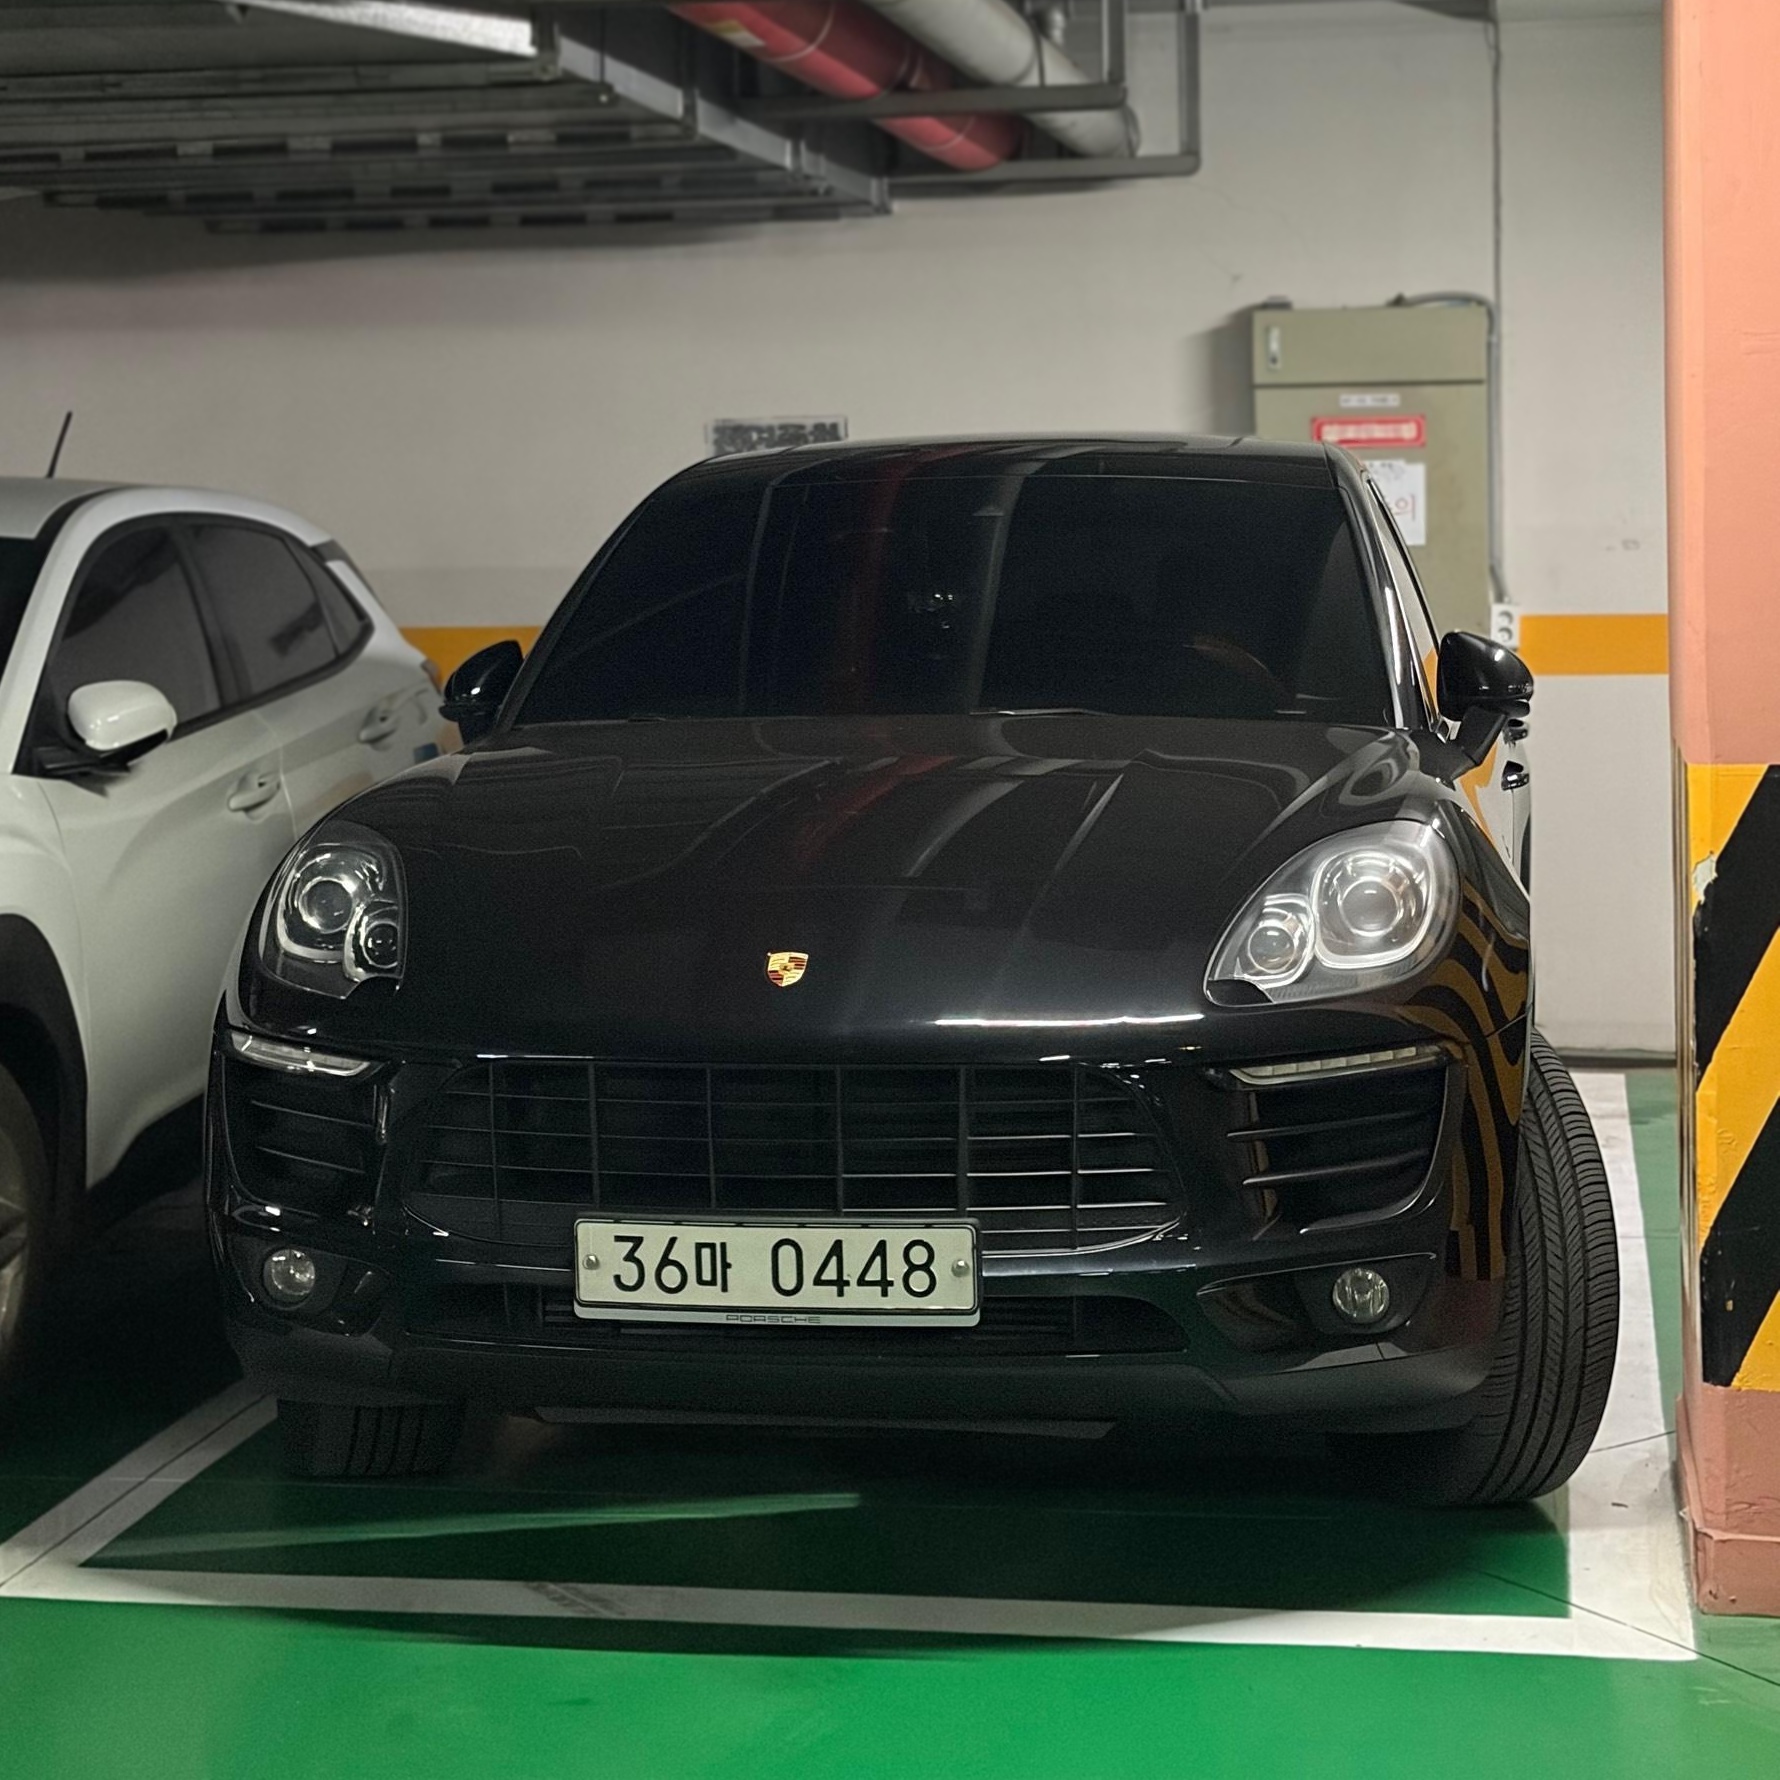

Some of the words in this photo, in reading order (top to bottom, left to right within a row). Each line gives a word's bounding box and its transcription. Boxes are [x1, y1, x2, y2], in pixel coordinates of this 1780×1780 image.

[613, 1235, 732, 1294] 36마
[771, 1238, 938, 1298] 0448
[726, 1314, 821, 1325] PORSCHE
